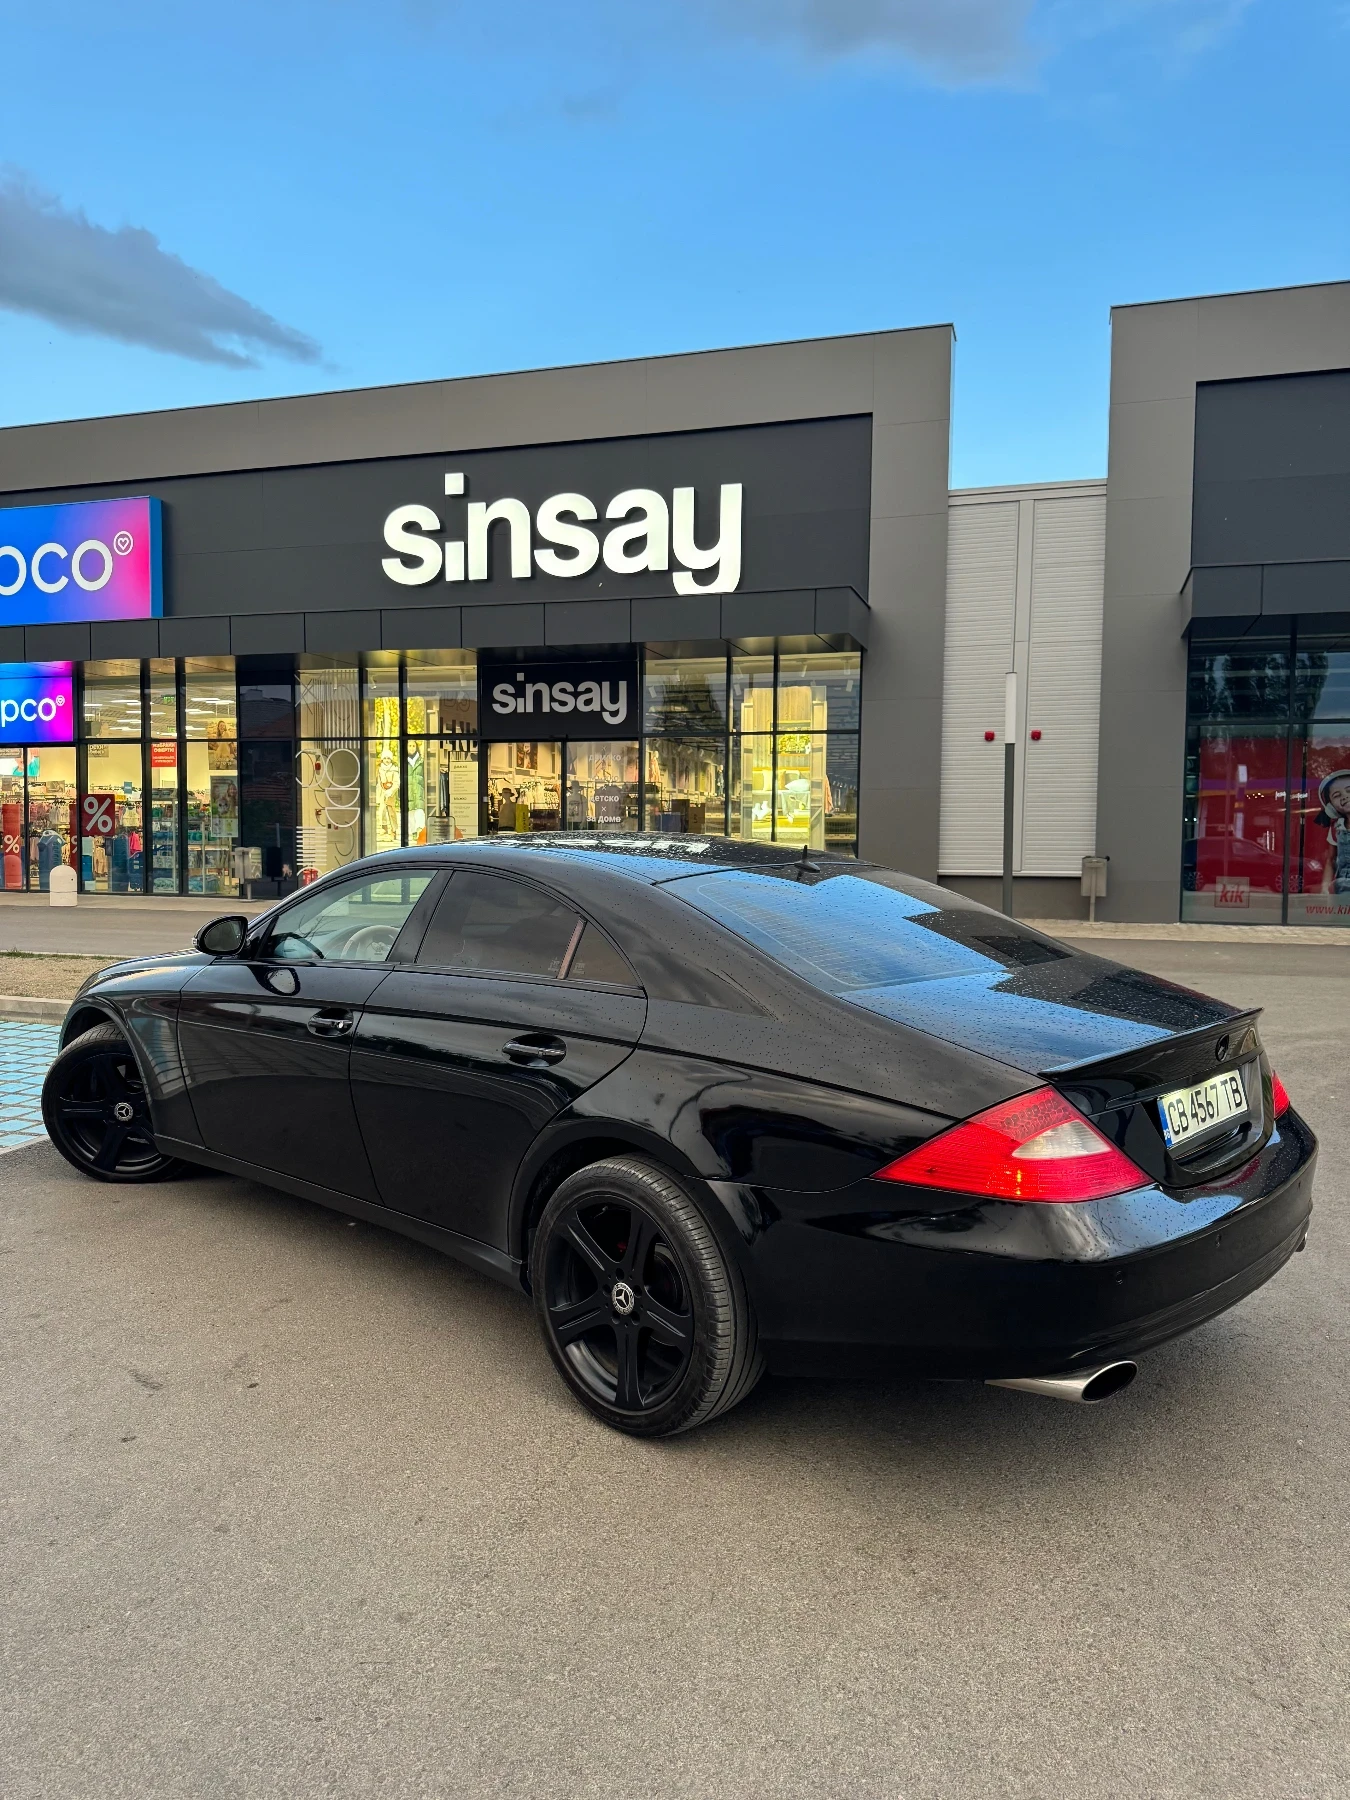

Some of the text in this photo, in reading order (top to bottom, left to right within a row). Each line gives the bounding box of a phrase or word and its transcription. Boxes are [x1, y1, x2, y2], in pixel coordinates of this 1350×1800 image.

[381, 472, 743, 595] sinsay
[491, 672, 627, 725] sinsay
[1219, 883, 1244, 903] kik
[1190, 1083, 1219, 1126] 4567
